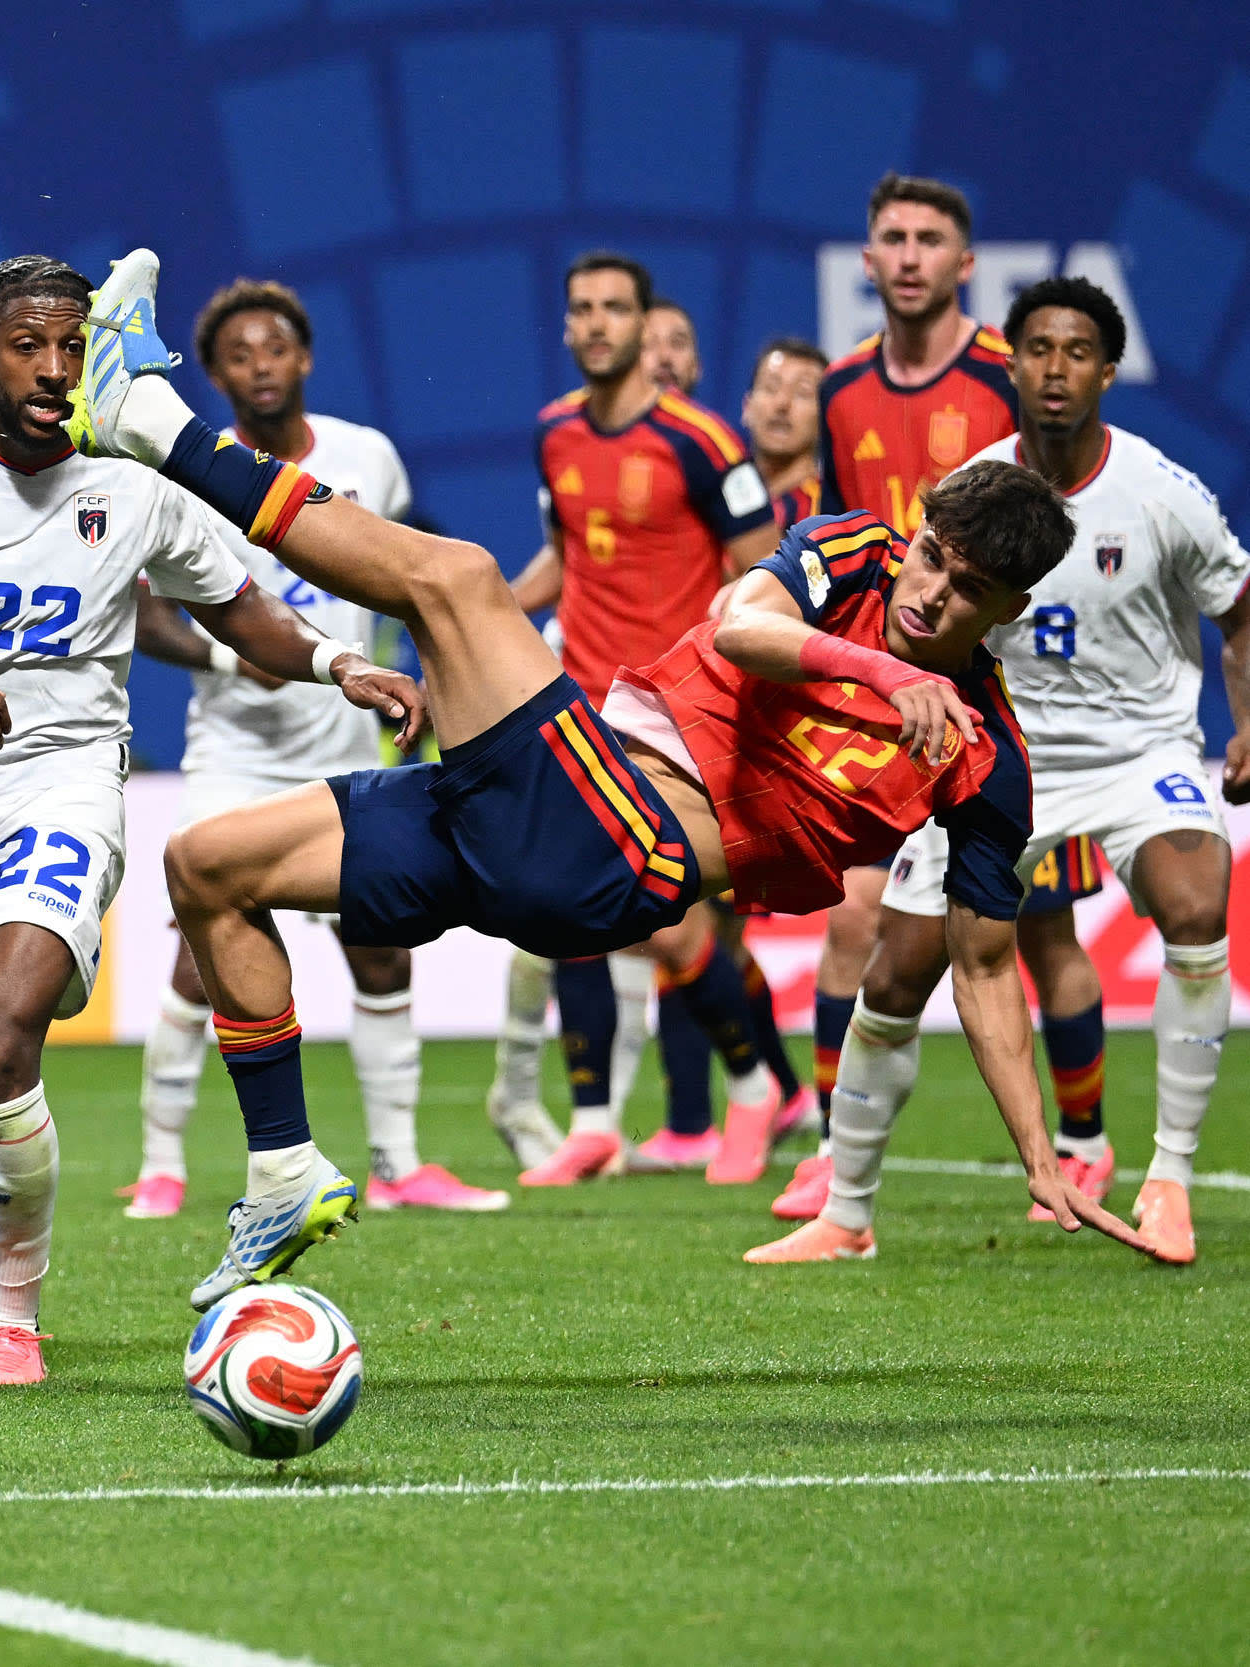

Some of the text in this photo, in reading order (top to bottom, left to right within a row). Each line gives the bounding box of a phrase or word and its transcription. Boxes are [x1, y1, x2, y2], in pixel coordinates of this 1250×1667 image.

[816, 242, 1155, 382] FFA
[77, 496, 107, 505] FCF
[1153, 773, 1207, 803] 6
[28, 891, 77, 918] capelli
